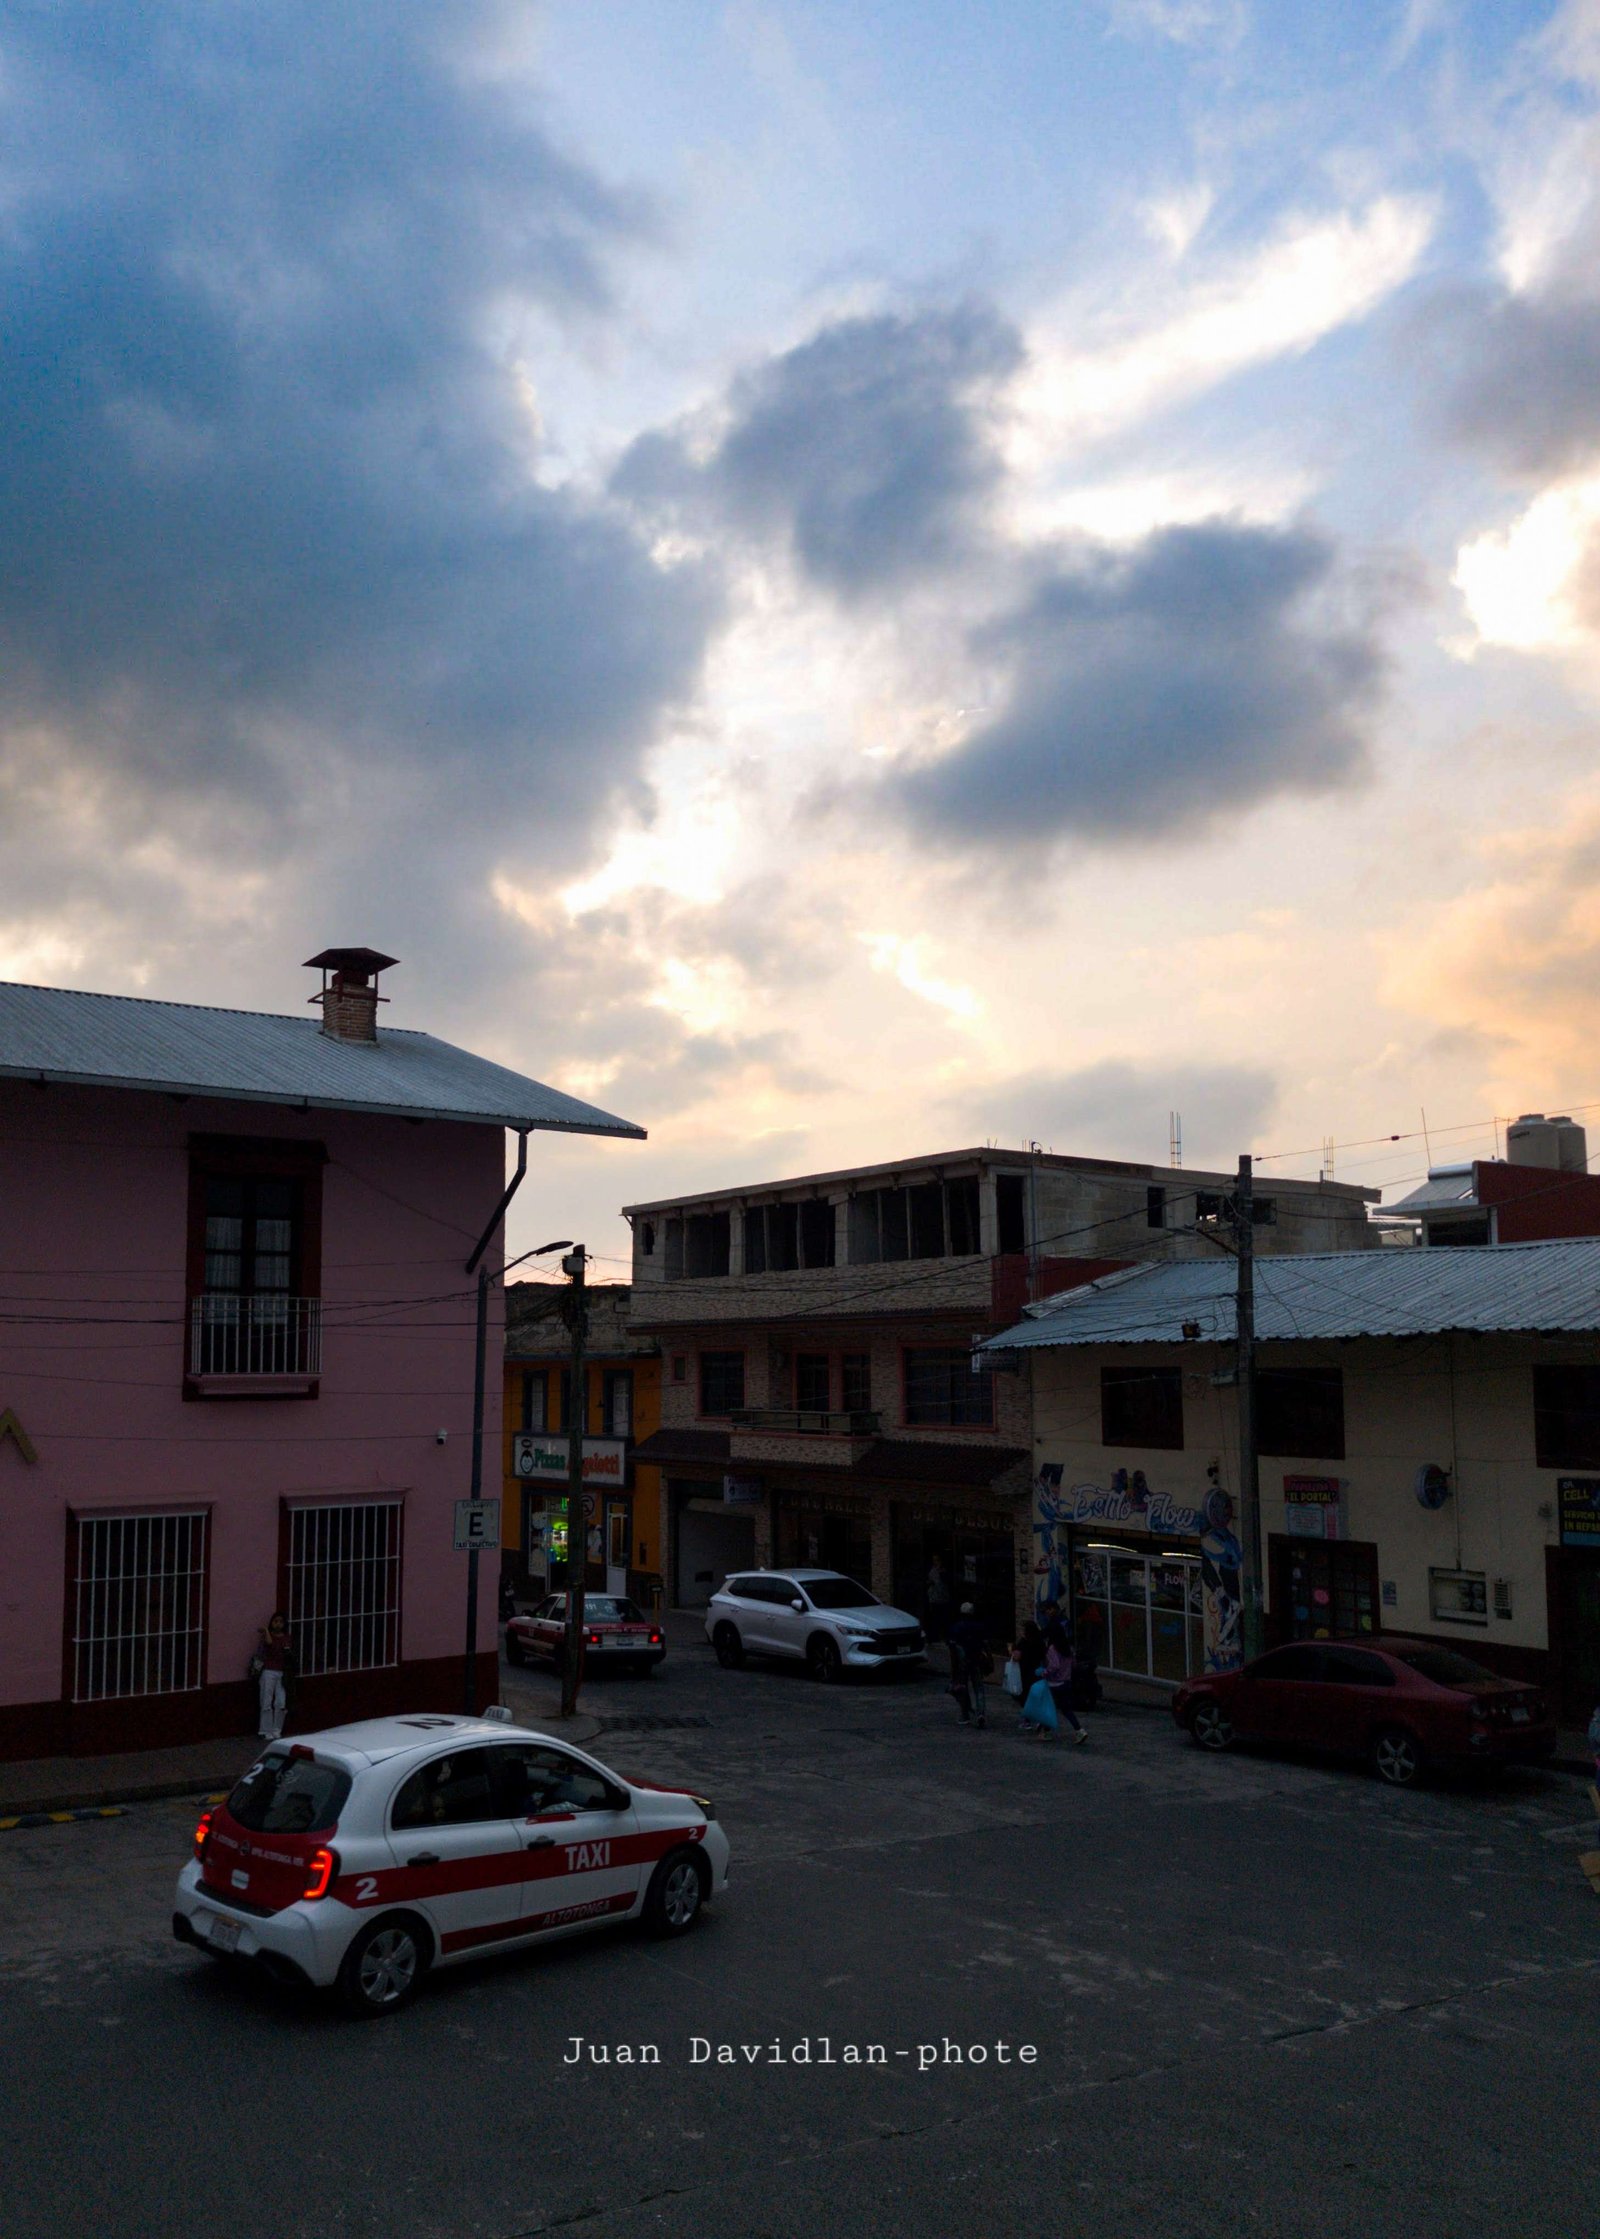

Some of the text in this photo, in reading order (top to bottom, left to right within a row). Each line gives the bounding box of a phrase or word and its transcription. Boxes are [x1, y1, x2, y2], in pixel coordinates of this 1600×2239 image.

[534, 1447, 566, 1470] Pizzas
[1563, 1488, 1590, 1501] CELL
[1071, 1484, 1196, 1530] Estilo Flow
[469, 1512, 483, 1536] E
[242, 1763, 264, 1784] 2
[688, 1827, 699, 1840] 2
[564, 1840, 611, 1872] TAXI
[355, 1876, 380, 1901] 2
[542, 1900, 611, 1926] ALTOTONGA
